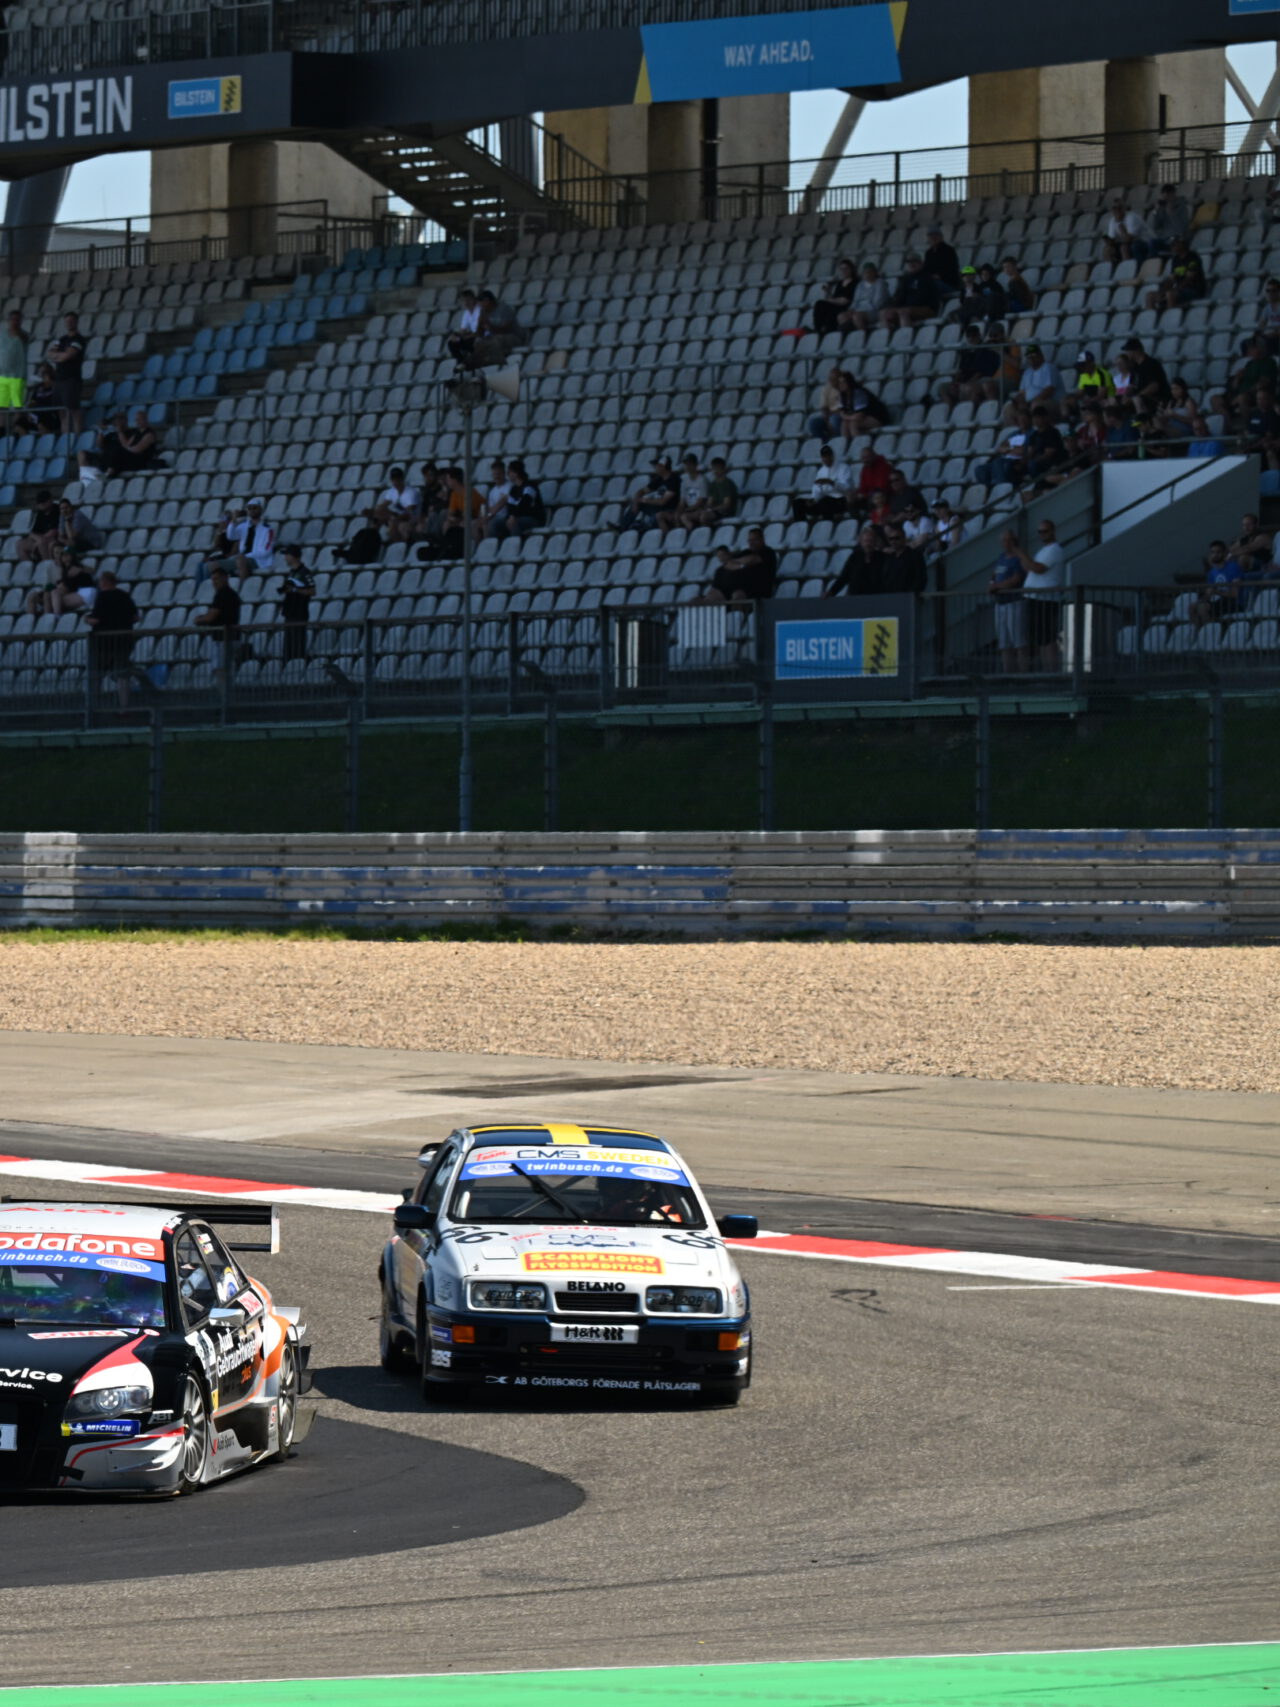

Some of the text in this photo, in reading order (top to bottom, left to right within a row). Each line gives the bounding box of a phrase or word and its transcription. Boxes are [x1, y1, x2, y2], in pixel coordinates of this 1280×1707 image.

[723, 39, 815, 68] WAY AHEAD.
[174, 89, 216, 108] BILSTEIN
[785, 636, 855, 662] BILSTEIN
[516, 1149, 581, 1160] CMS
[586, 1150, 669, 1166] SWEDEN
[526, 1162, 624, 1174] twinbusch.de
[529, 1251, 657, 1265] SCANFLIGHT
[529, 1261, 659, 1274] FLYGSPEDITION
[567, 1280, 626, 1292] BELANO
[564, 1325, 600, 1339] H&R
[513, 1376, 528, 1386] AB
[531, 1375, 589, 1388] GÖTEBORGS
[592, 1377, 641, 1390] FÖRENADE
[86, 1423, 132, 1433] MICHELIN
